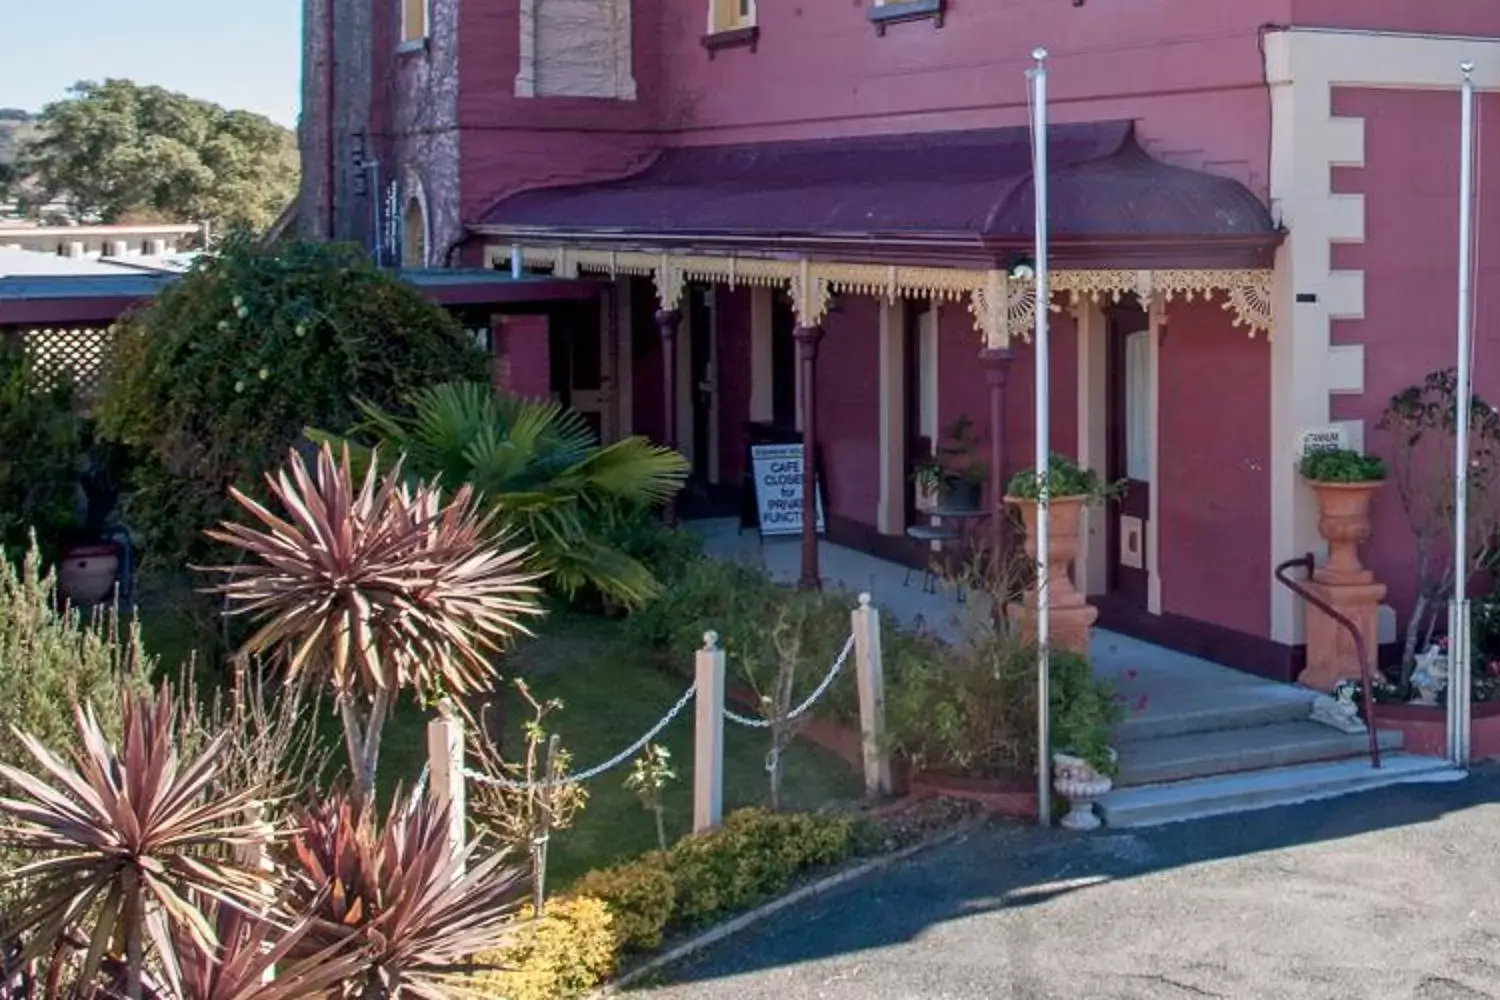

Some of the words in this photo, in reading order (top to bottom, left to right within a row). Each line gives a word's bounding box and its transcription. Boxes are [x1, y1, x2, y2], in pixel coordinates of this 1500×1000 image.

[770, 461, 801, 474] CAFE
[763, 473, 804, 486] CLOSE
[763, 511, 802, 524] FUNCT
